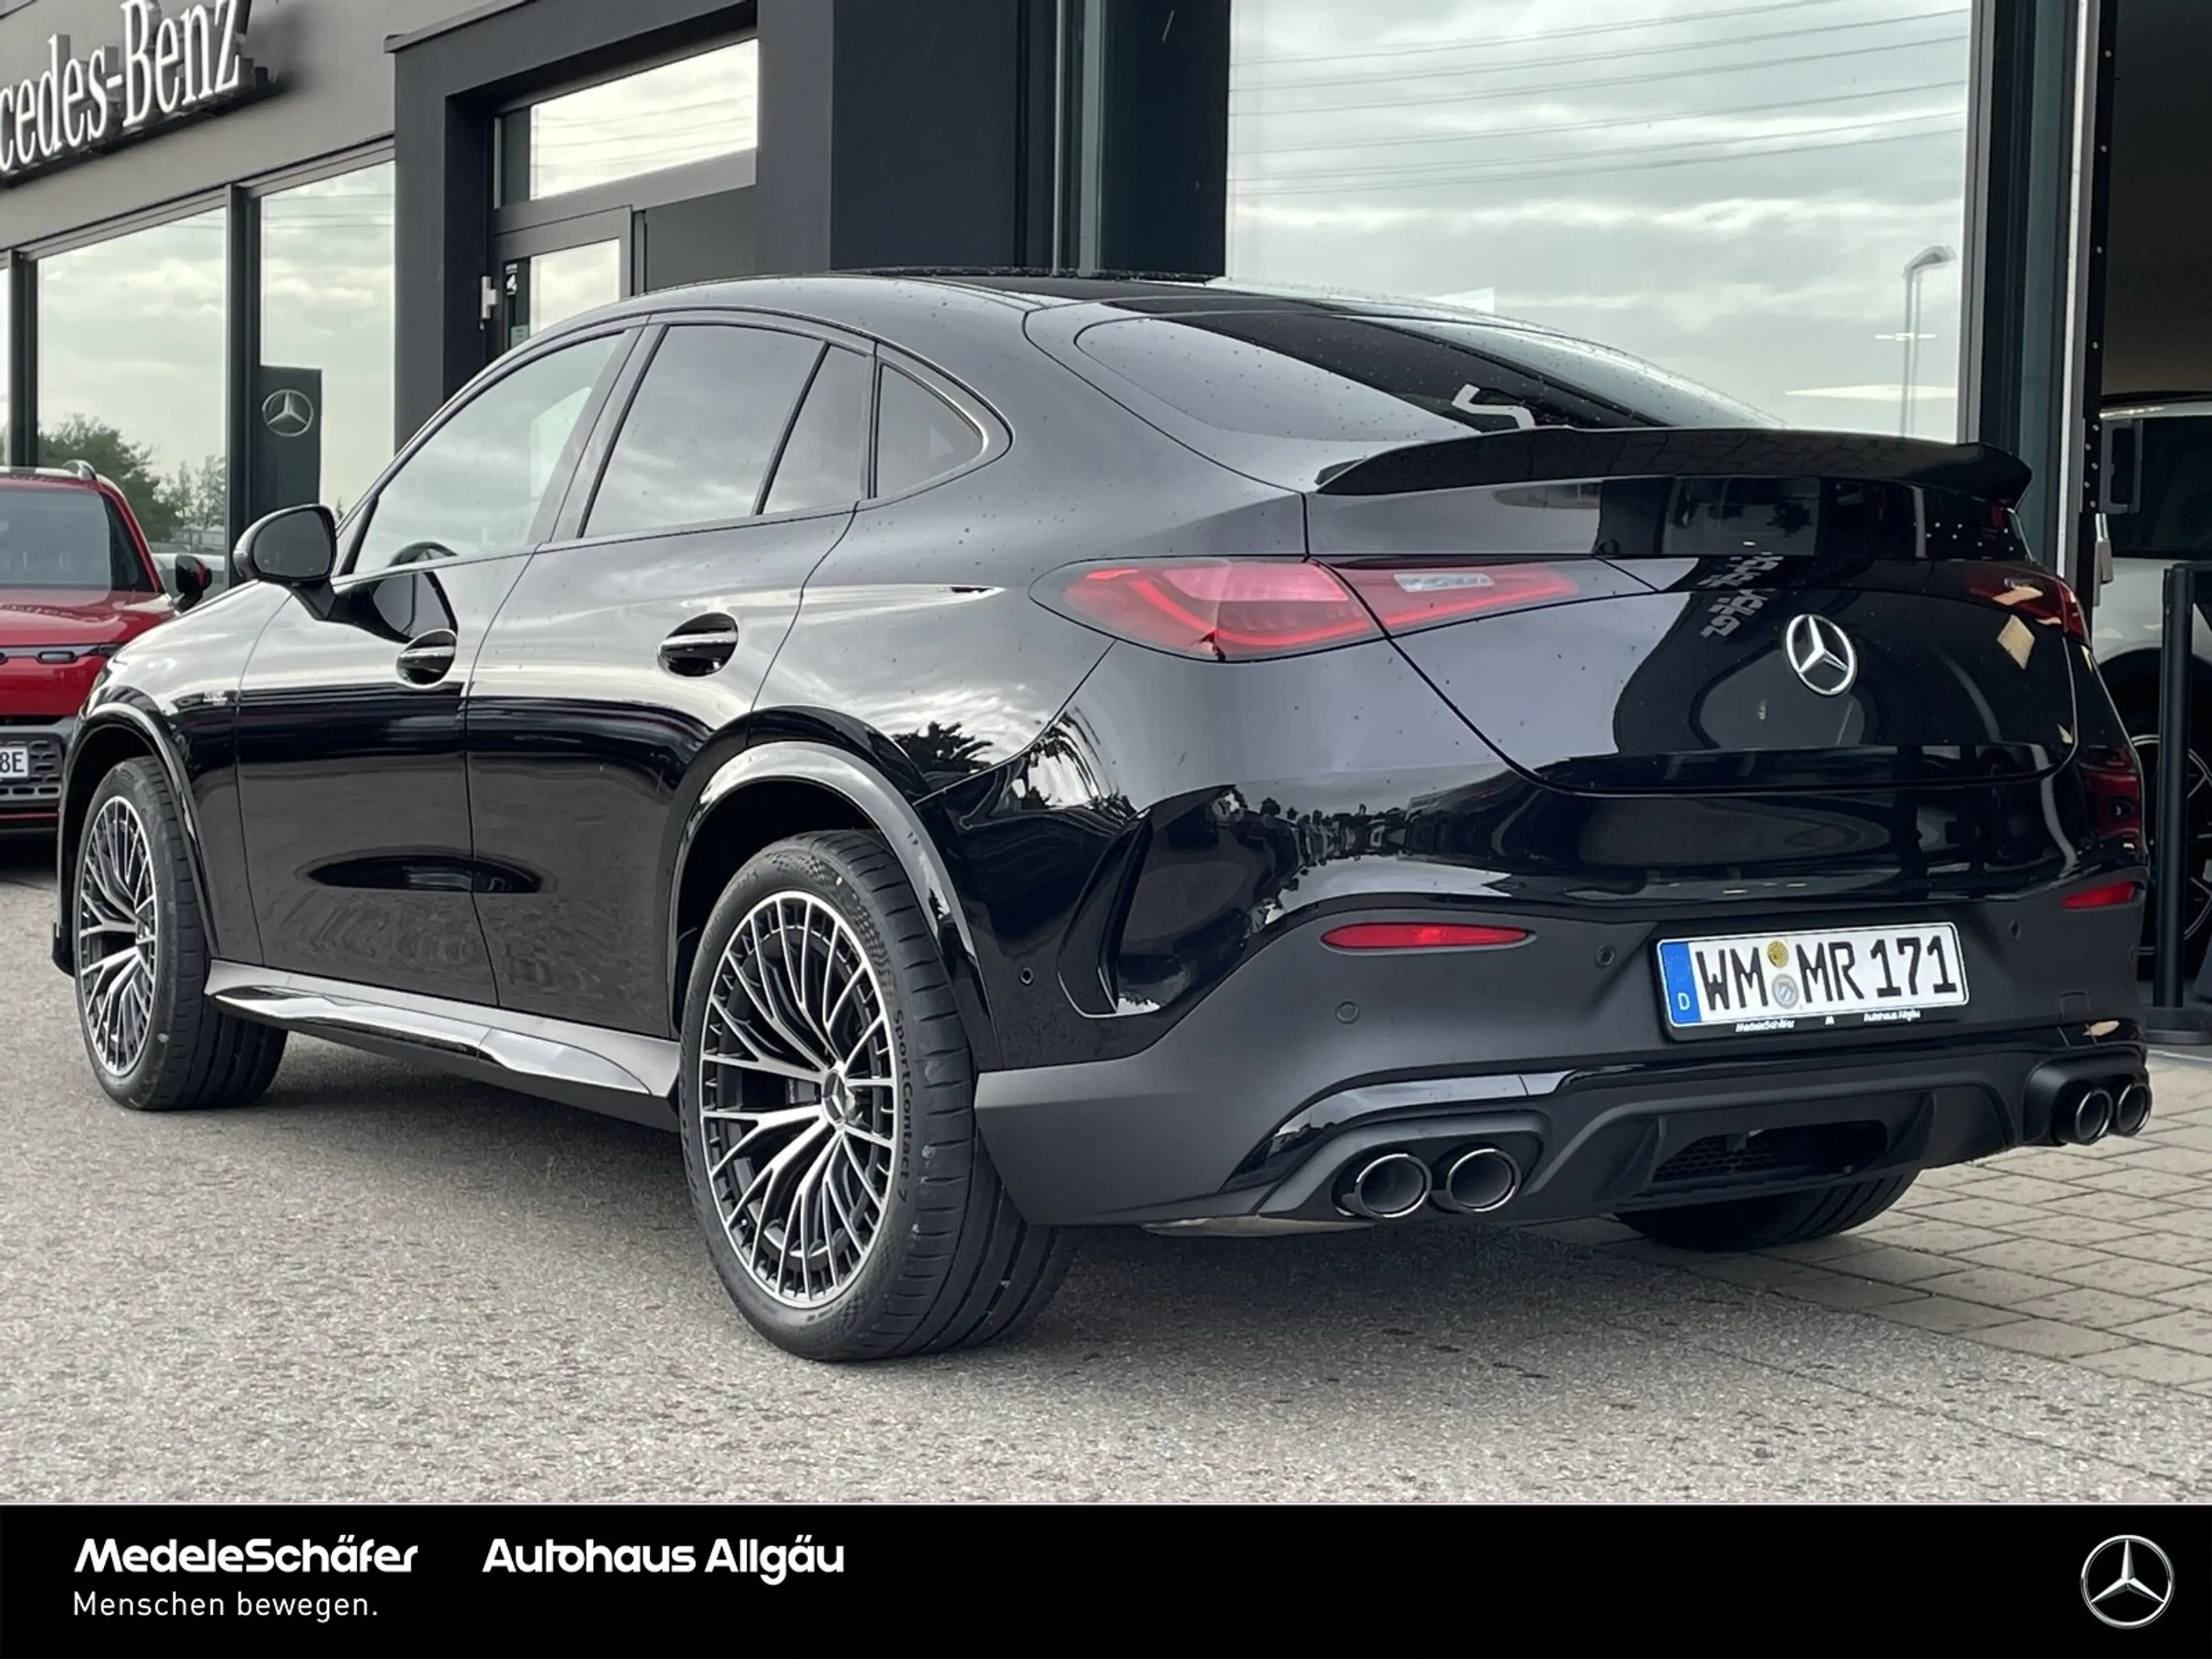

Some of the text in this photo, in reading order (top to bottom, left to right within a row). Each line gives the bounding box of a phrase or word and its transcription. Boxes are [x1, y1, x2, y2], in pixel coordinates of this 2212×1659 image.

[1695, 935, 1957, 1010] WM MR 171
[1677, 992, 1690, 1010] D
